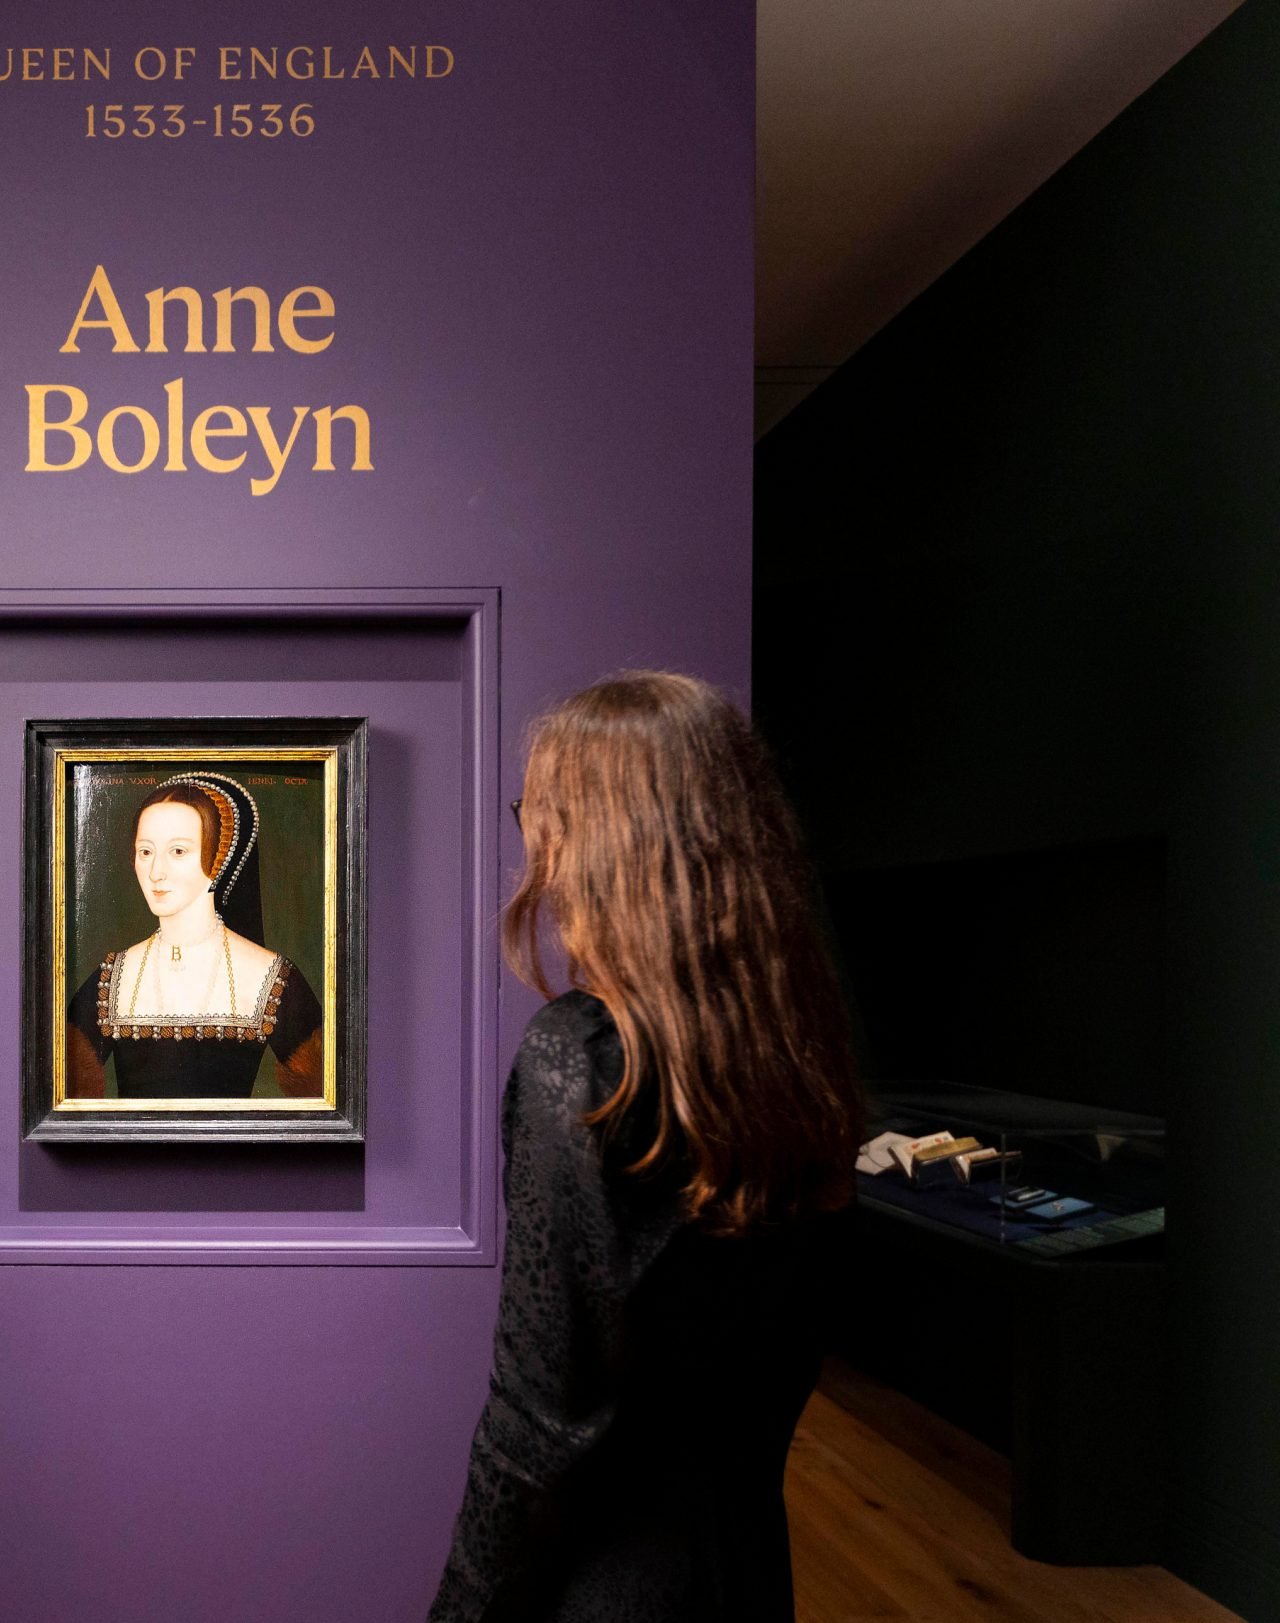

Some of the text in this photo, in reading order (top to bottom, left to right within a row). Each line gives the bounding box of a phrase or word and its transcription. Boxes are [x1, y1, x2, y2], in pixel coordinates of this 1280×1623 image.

[133, 46, 197, 80] OF
[218, 44, 456, 80] ENGLAND
[85, 102, 316, 139] 1533-1536
[58, 264, 336, 355] Anne
[23, 377, 375, 497] Boleyn
[171, 944, 182, 961] B
